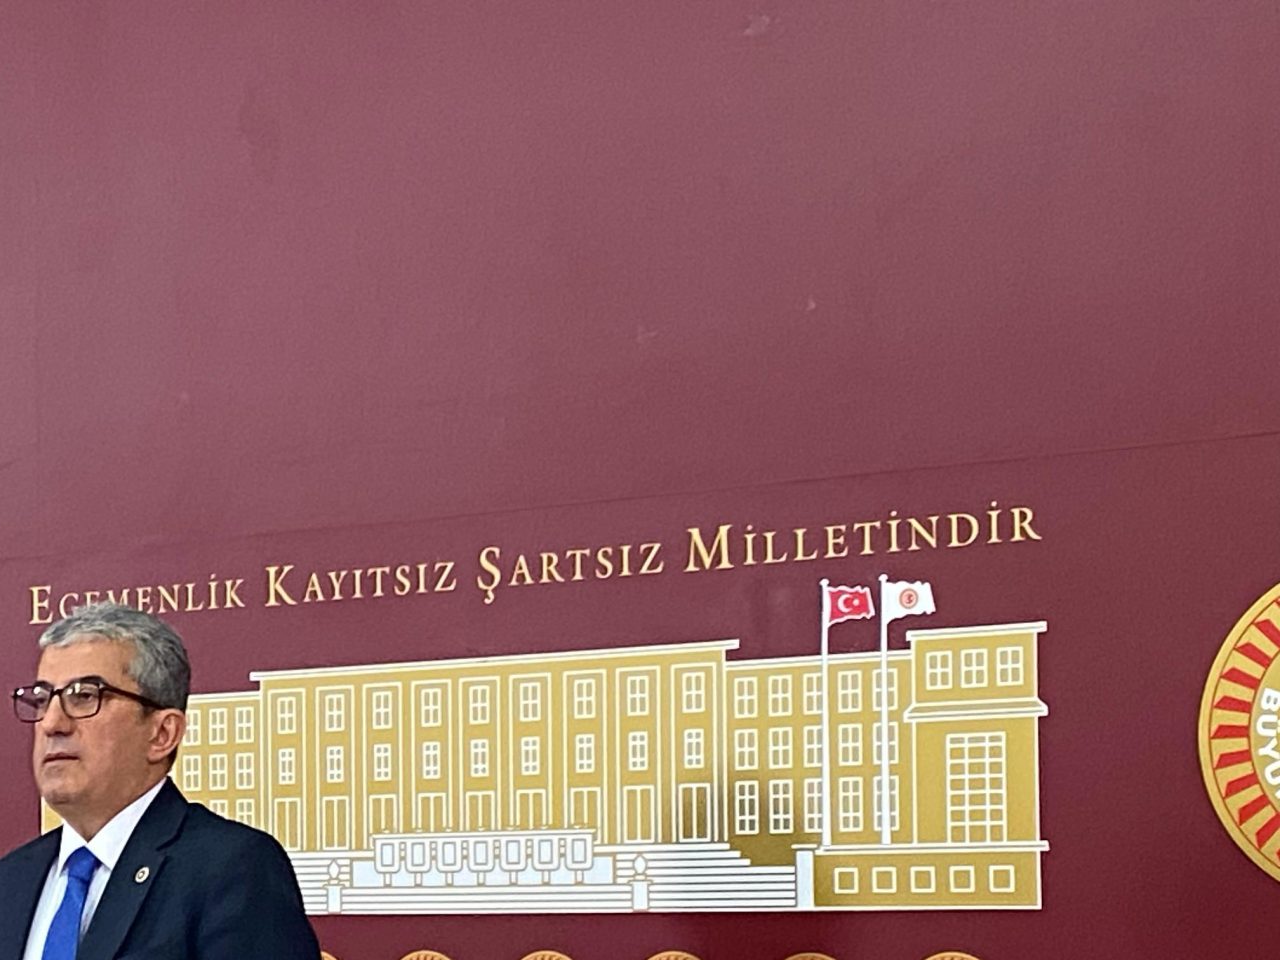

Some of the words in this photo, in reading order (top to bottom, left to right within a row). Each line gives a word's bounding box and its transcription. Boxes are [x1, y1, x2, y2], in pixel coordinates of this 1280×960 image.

[264, 560, 456, 607] KAYITSIZ
[477, 543, 664, 605] ŞARTSIZ
[683, 500, 1042, 573] MİLLETİNDİR
